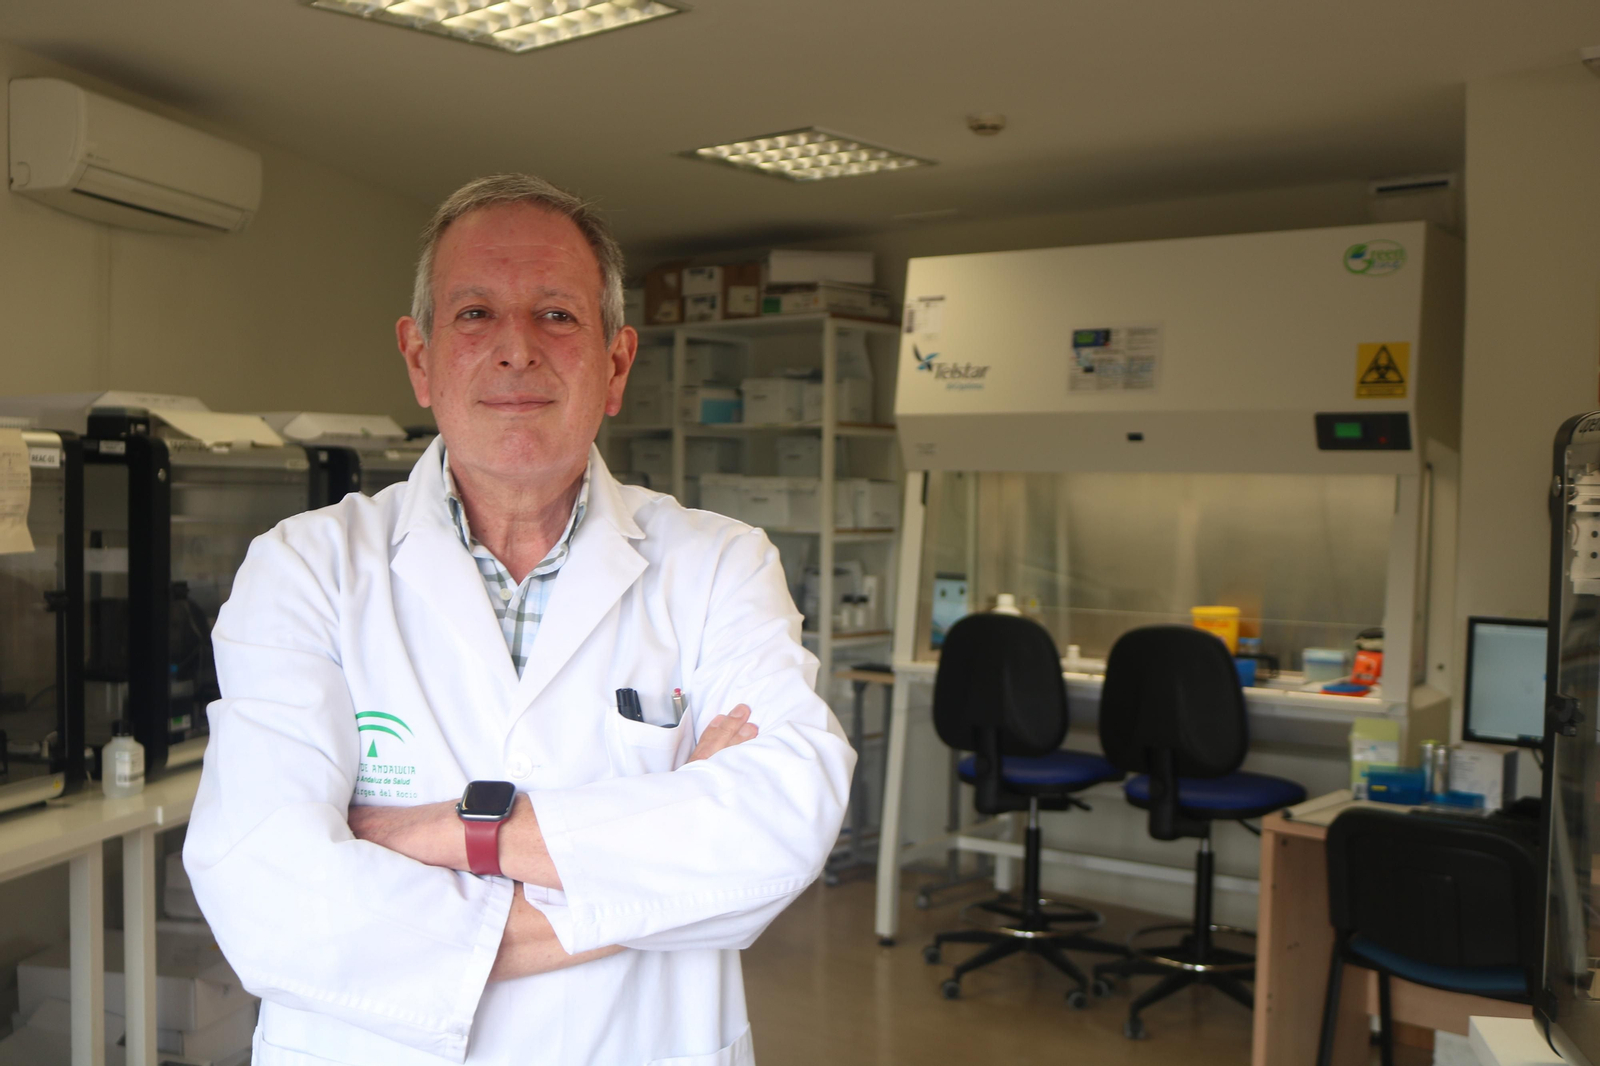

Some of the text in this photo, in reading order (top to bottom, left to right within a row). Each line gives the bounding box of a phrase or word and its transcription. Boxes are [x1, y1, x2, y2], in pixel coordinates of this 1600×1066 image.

[934, 361, 990, 379] Telstar
[360, 763, 416, 774] DE ANDALUCIA
[360, 775, 382, 784] Andaluz
[383, 777, 391, 785] de
[392, 777, 411, 785] Salud
[379, 788, 392, 797] del
